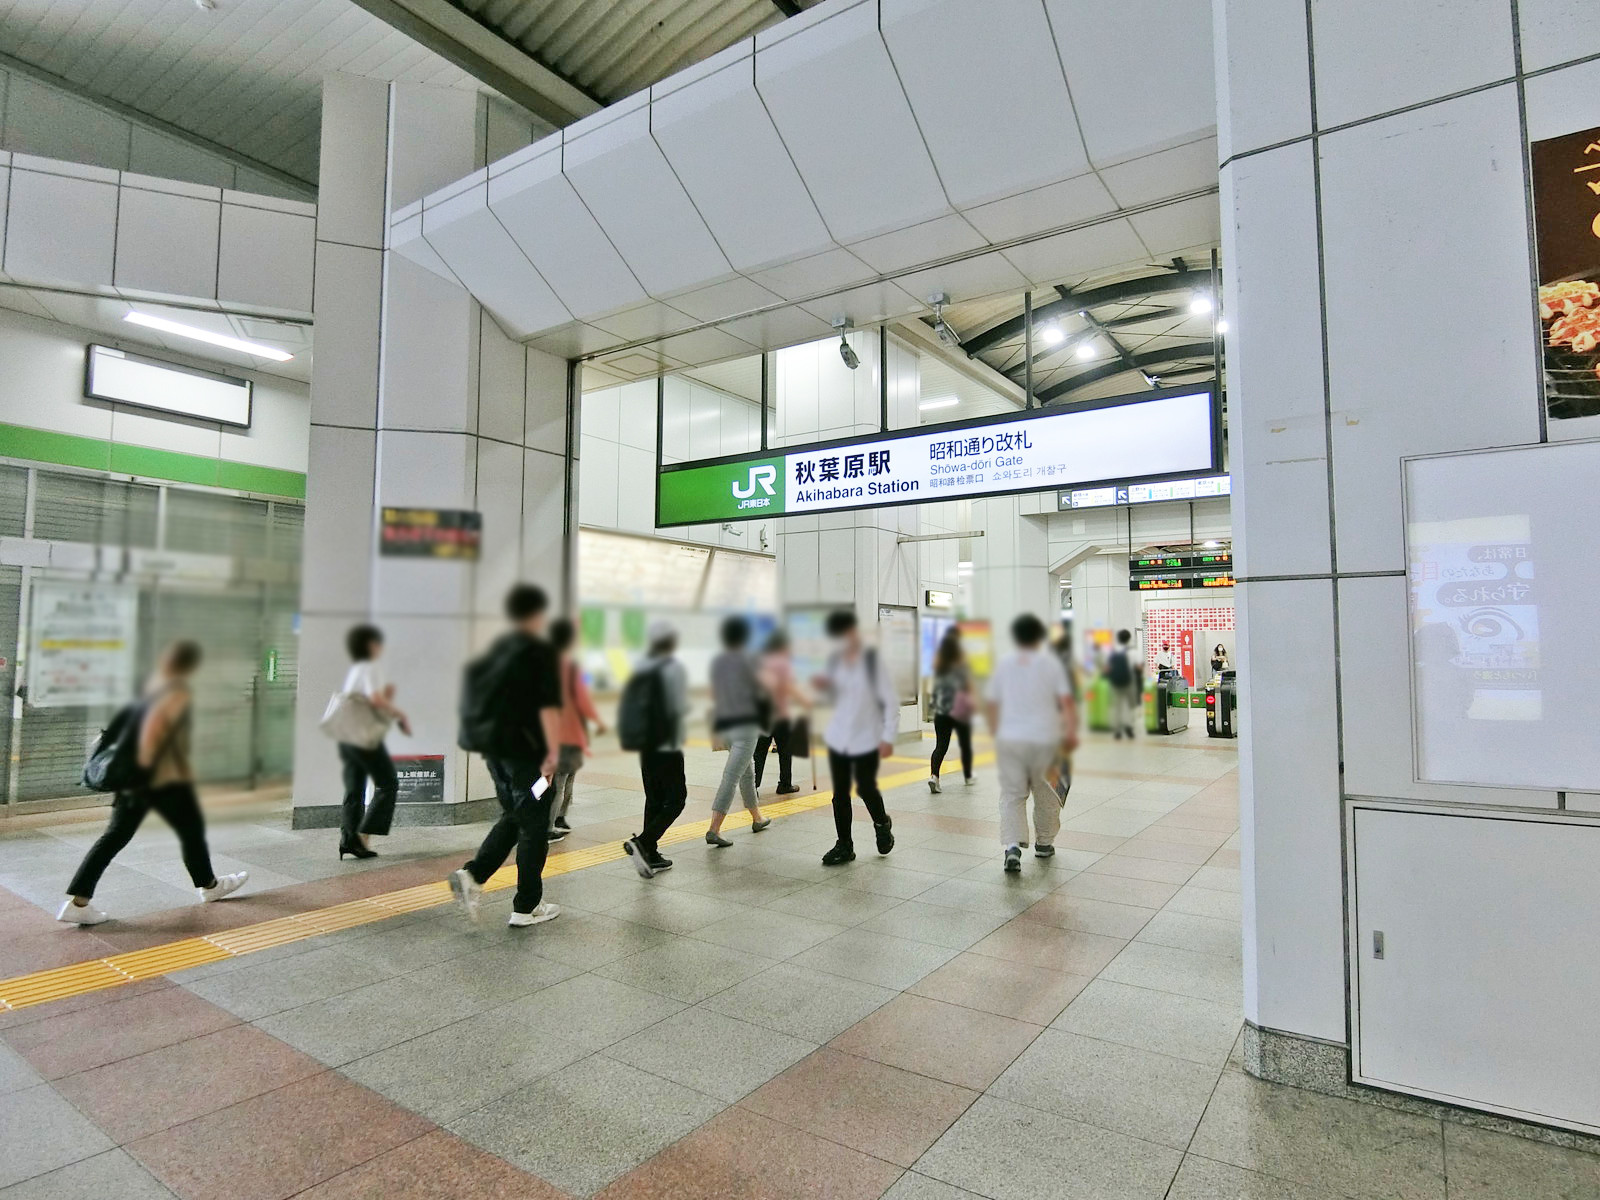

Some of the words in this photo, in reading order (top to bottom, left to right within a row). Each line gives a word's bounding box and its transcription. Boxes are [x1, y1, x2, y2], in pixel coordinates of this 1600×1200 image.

[929, 430, 1033, 461] 昭和通り改札
[795, 450, 891, 486] 秋葉原駅
[930, 457, 992, 475] Shōwa-dōri
[995, 455, 1024, 468] Gate
[992, 468, 1033, 481] 쇼와도리
[1036, 463, 1067, 476] 개찰구
[732, 464, 777, 499] JR
[796, 485, 863, 503] Akihabara
[868, 479, 920, 496] Station
[737, 498, 771, 510] JR東日本
